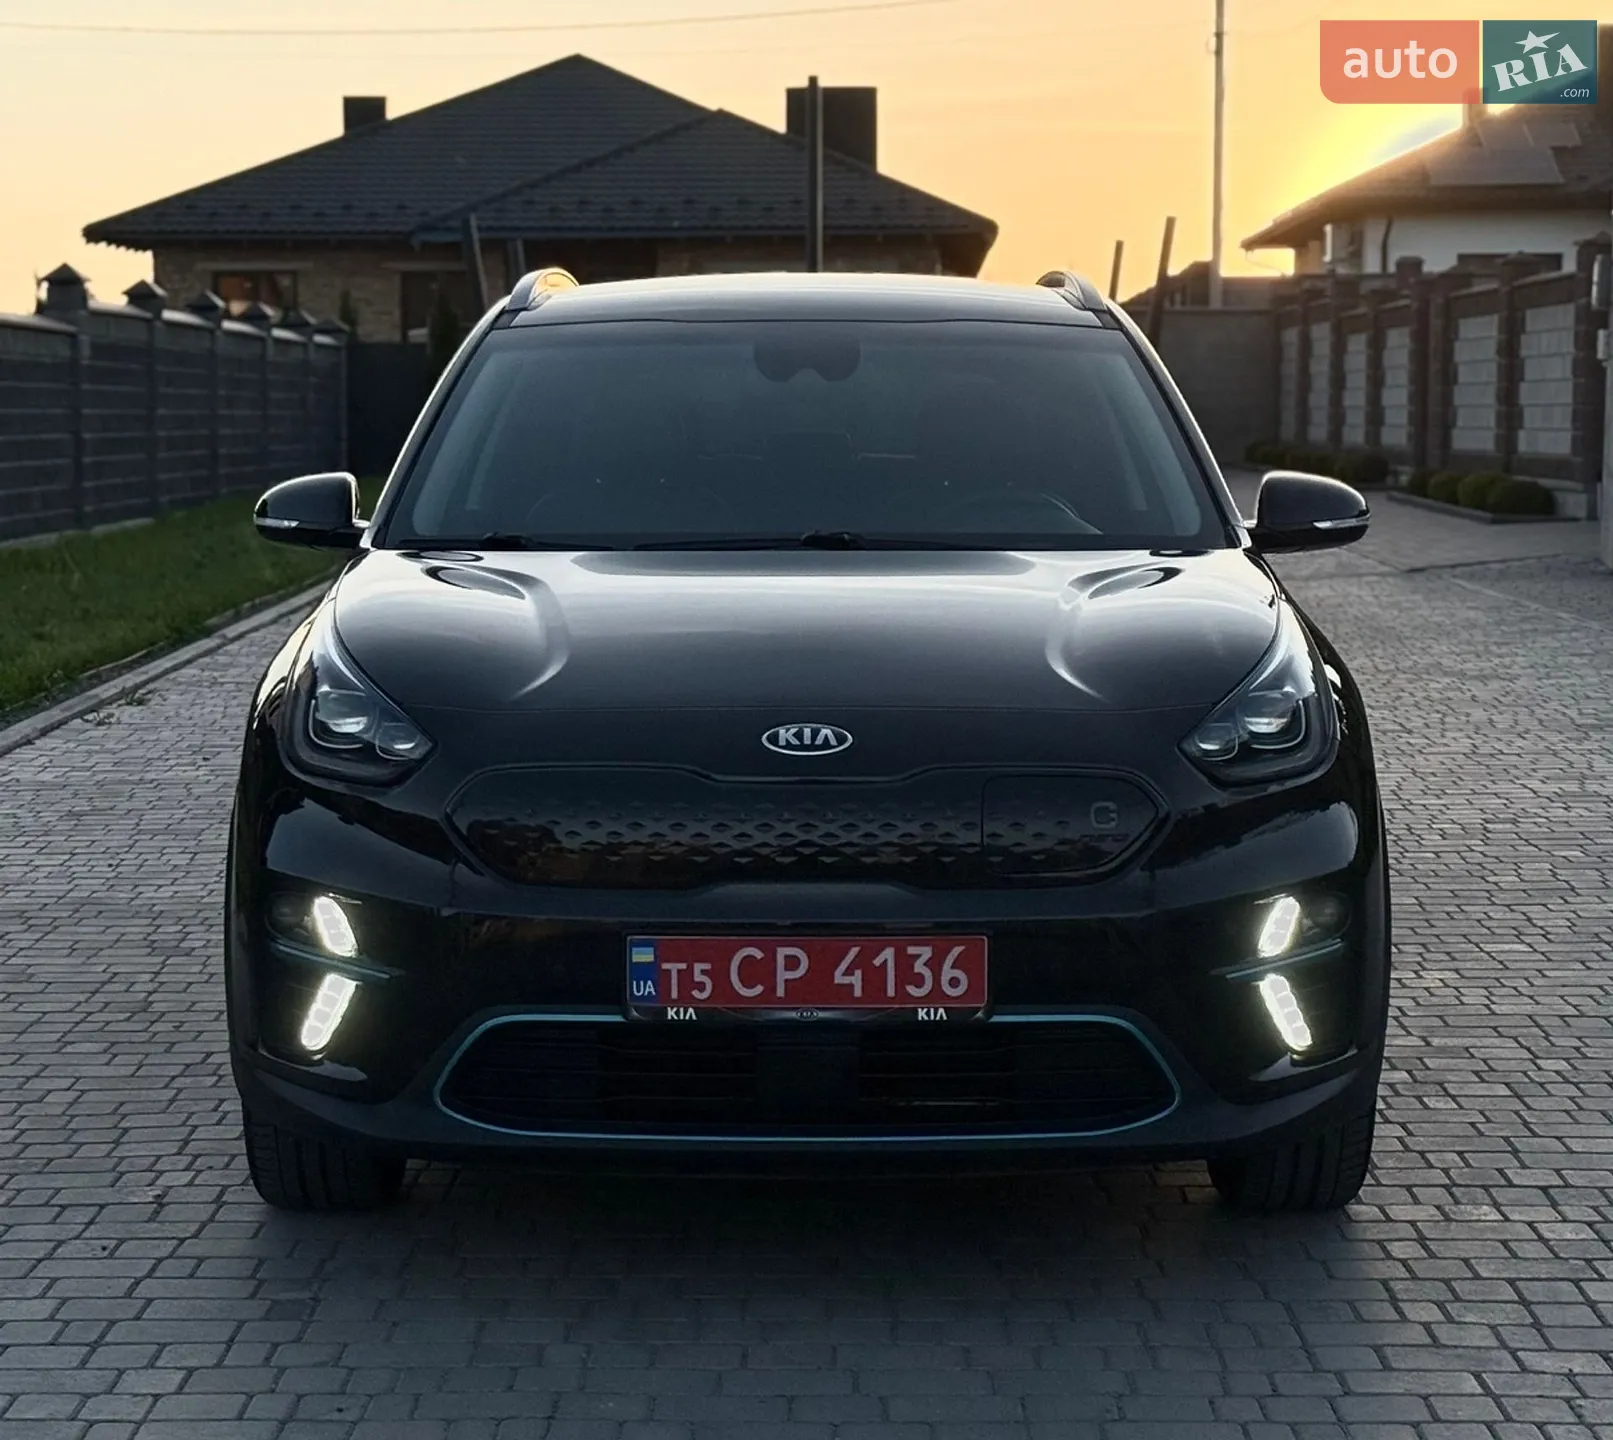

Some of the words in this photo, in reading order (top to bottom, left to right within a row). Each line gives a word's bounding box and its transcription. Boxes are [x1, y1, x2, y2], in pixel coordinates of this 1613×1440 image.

[778, 727, 838, 746] KIA
[661, 962, 713, 1000] T5
[730, 946, 810, 998] CP
[833, 946, 969, 998] 4136
[633, 980, 656, 996] UA
[666, 1007, 698, 1021] KIA
[917, 1007, 948, 1021] KIA
